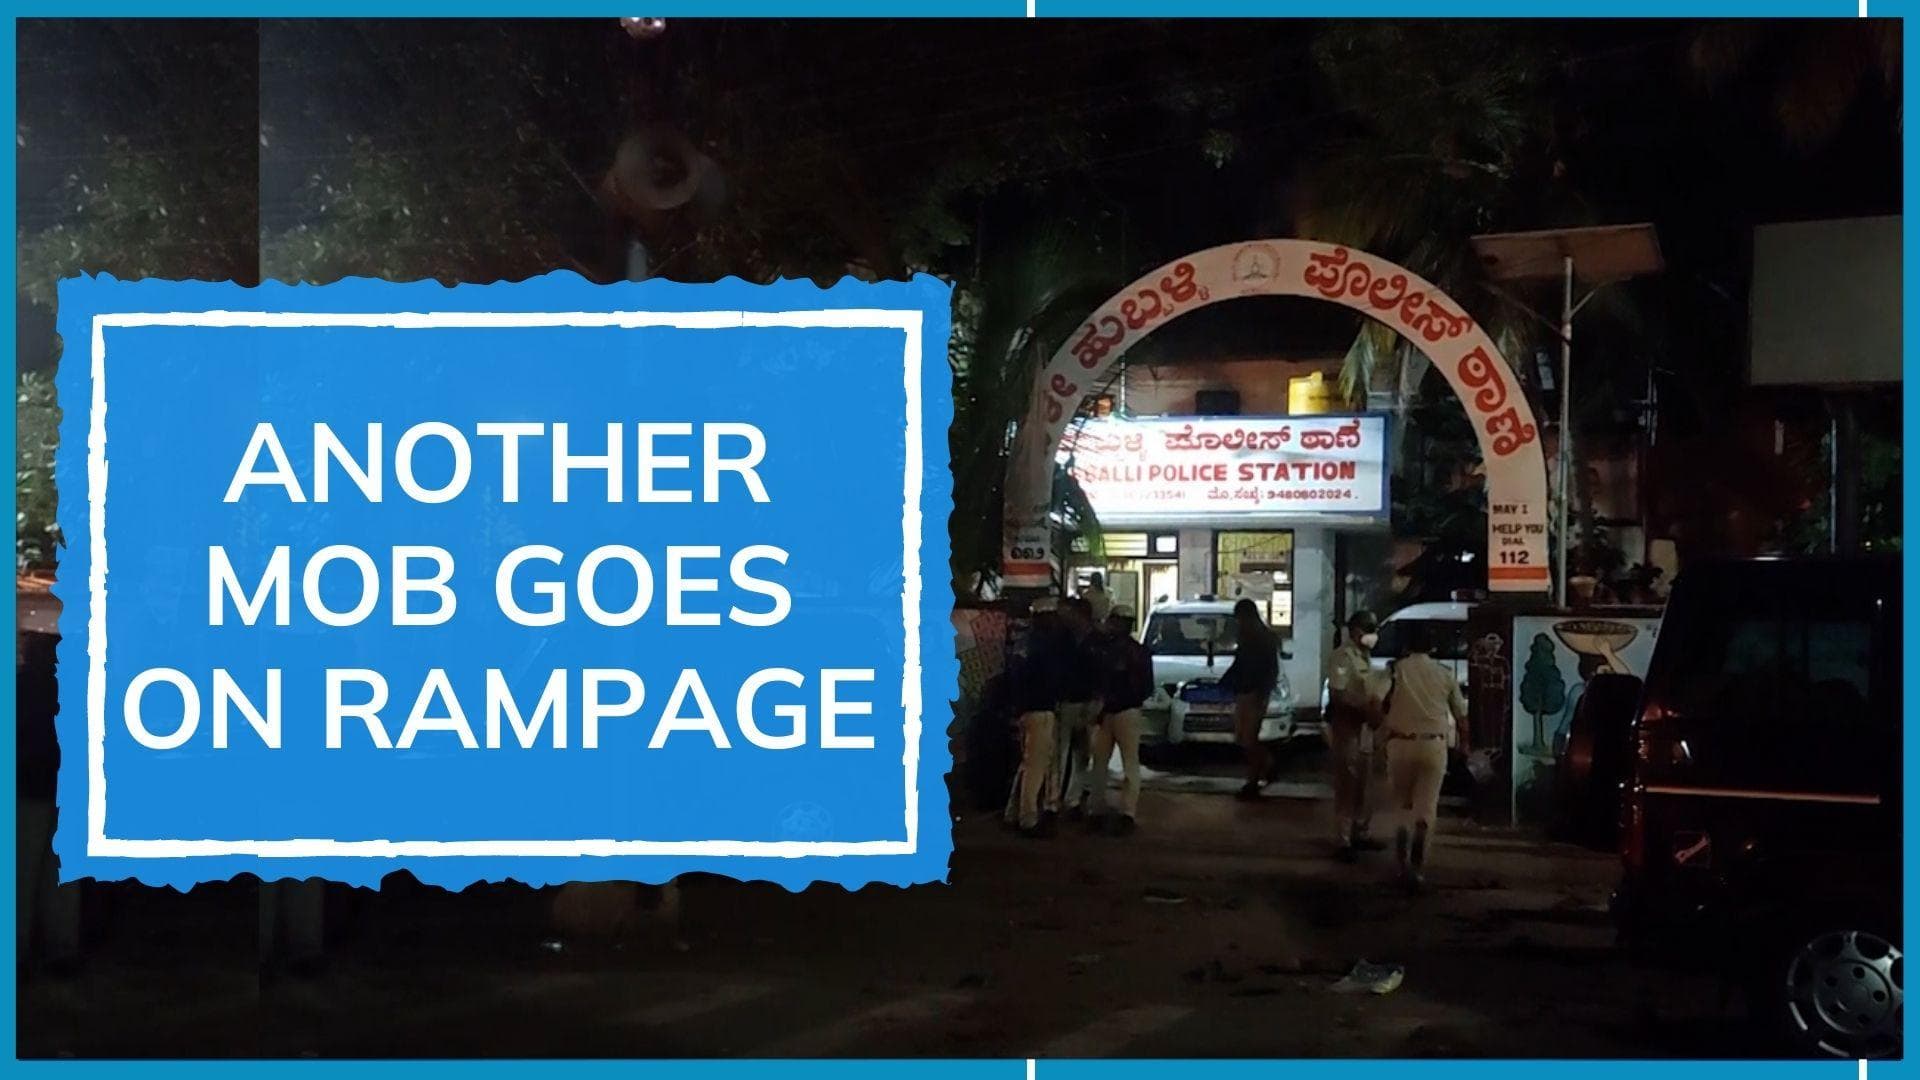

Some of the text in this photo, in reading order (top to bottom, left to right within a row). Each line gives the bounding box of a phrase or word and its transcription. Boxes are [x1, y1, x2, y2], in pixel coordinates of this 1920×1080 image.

[1149, 464, 1228, 481] POLICE
[1238, 461, 1356, 482] STATION
[1493, 504, 1518, 515] MAY
[1492, 523, 1544, 535] HELP YOU
[1500, 548, 1529, 569] 112
